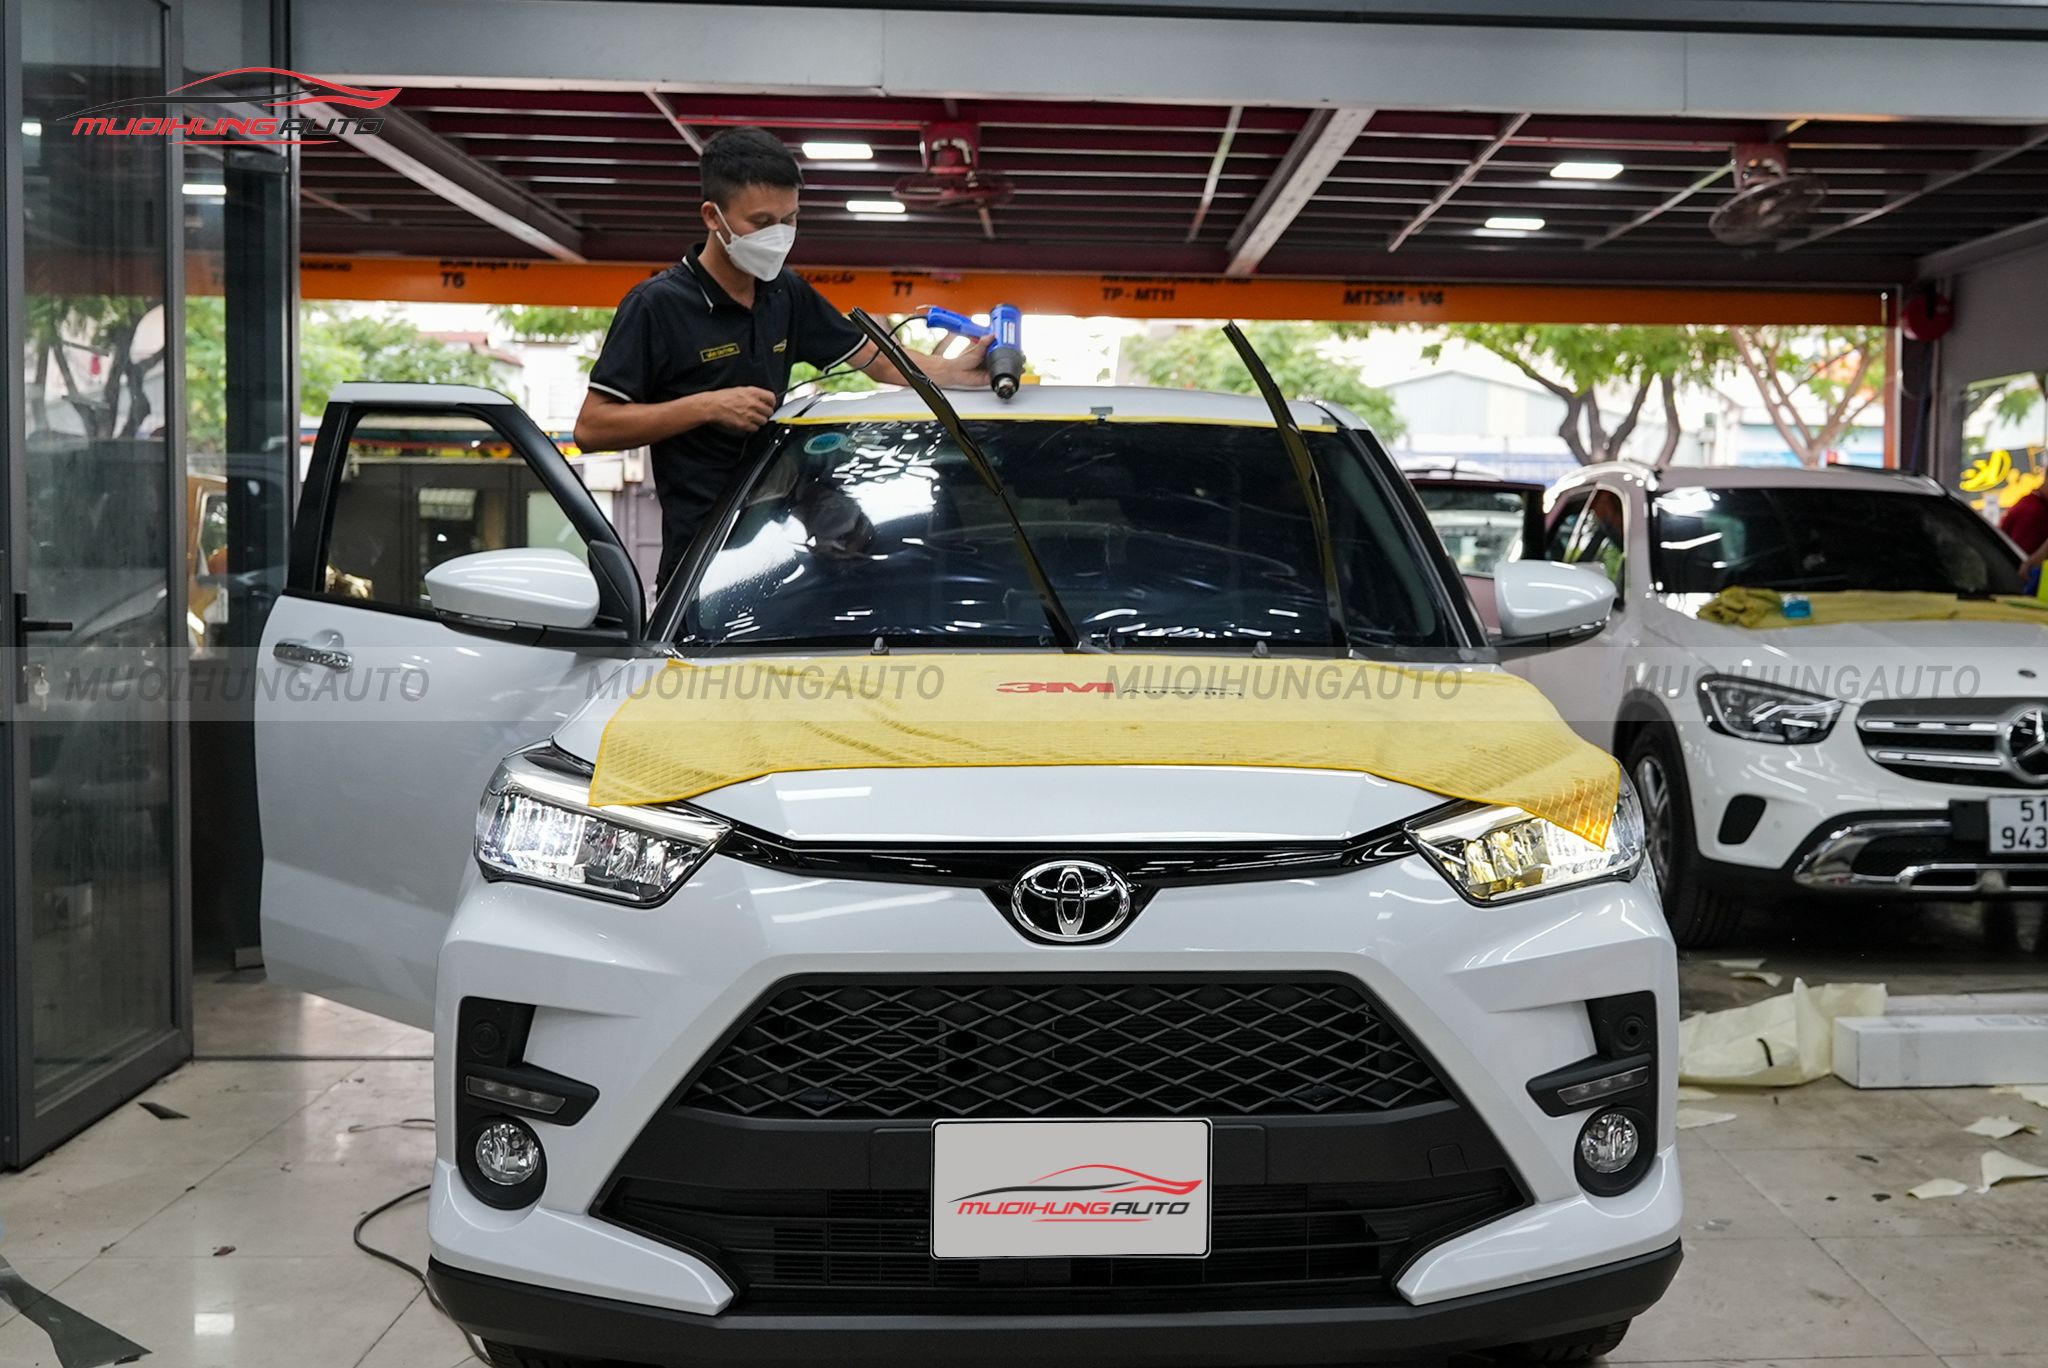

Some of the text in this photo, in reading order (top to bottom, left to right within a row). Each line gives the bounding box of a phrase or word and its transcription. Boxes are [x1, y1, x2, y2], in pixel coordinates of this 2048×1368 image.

[441, 271, 465, 288] T6
[892, 280, 914, 297] T1
[1102, 287, 1124, 300] TP
[1343, 289, 1405, 304] MTSM
[996, 682, 1114, 693] 3M
[2021, 800, 2048, 821] 51
[2002, 826, 2048, 848] 943
